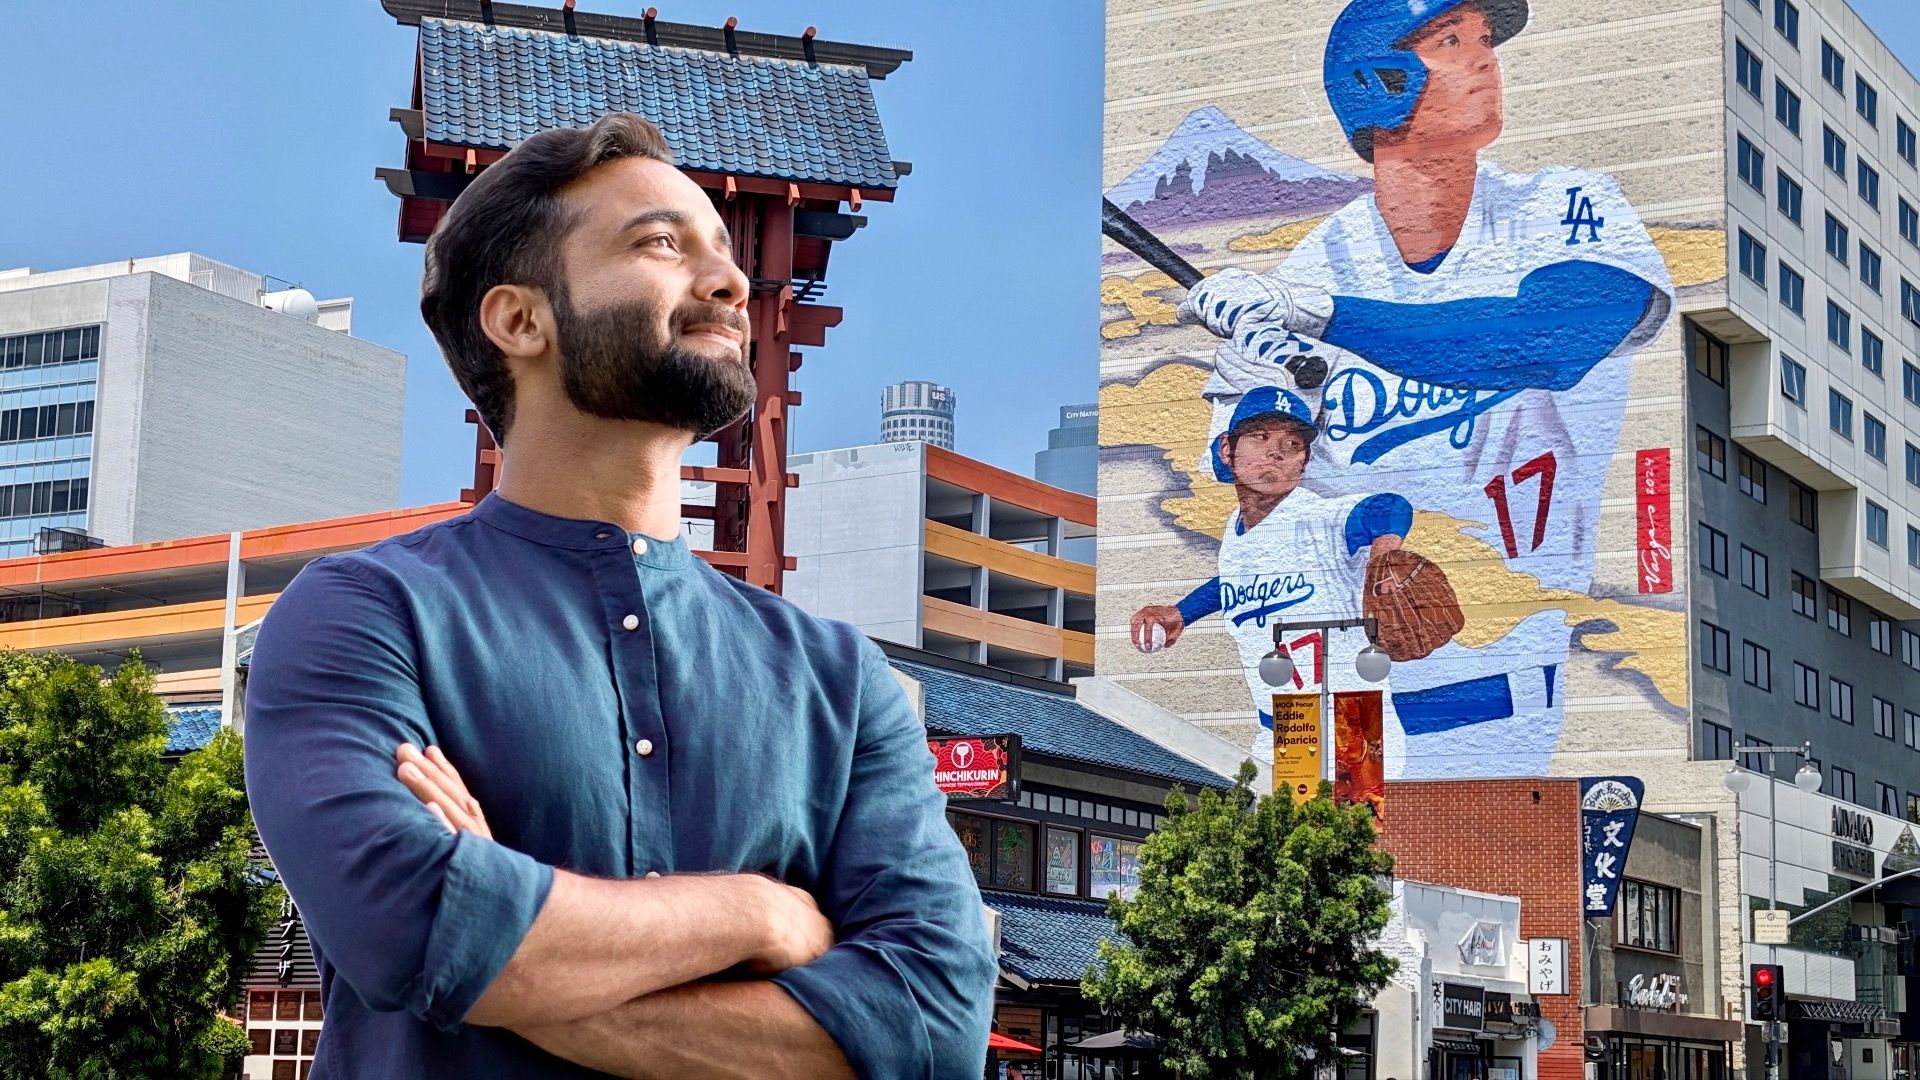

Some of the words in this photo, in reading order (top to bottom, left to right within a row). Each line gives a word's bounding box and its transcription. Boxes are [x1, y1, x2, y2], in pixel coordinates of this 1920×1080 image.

[1560, 187, 1604, 246] LA
[1274, 391, 1292, 414] LA
[1644, 457, 1655, 495] 2024
[1484, 451, 1557, 559] 17
[1220, 573, 1314, 627] Dodgers
[1276, 711, 1305, 720] Eddie
[1276, 723, 1316, 733] Rodolfo
[1276, 735, 1318, 747] Aparicio
[1586, 820, 1625, 910] 文化堂
[1539, 941, 1553, 991] おみやげ
[1444, 998, 1462, 1014] CITY
[1463, 1000, 1481, 1017] HAIR
